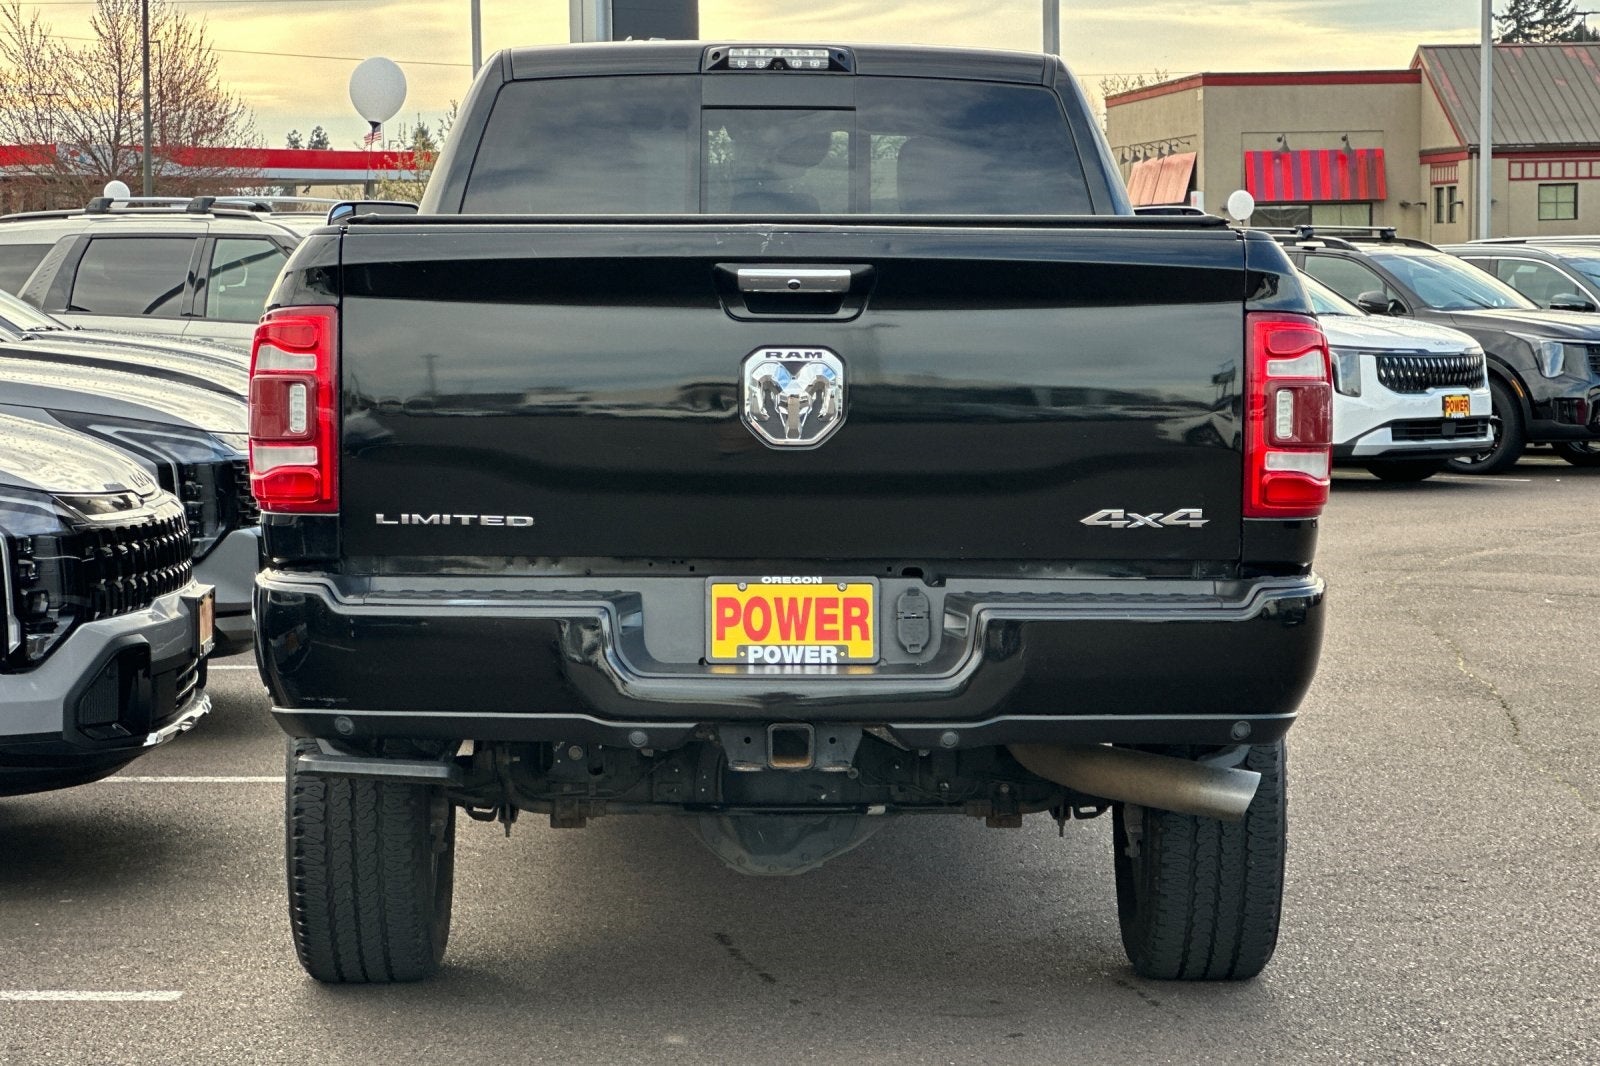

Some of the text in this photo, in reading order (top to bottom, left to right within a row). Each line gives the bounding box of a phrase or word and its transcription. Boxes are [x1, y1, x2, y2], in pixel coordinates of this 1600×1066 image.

[765, 351, 823, 359] RAM
[1445, 400, 1469, 412] POWER
[375, 513, 534, 527] LIMITED
[1079, 508, 1211, 529] 4x4
[761, 576, 823, 584] OREGON
[715, 597, 870, 641] POWER
[747, 646, 838, 664] POWER
